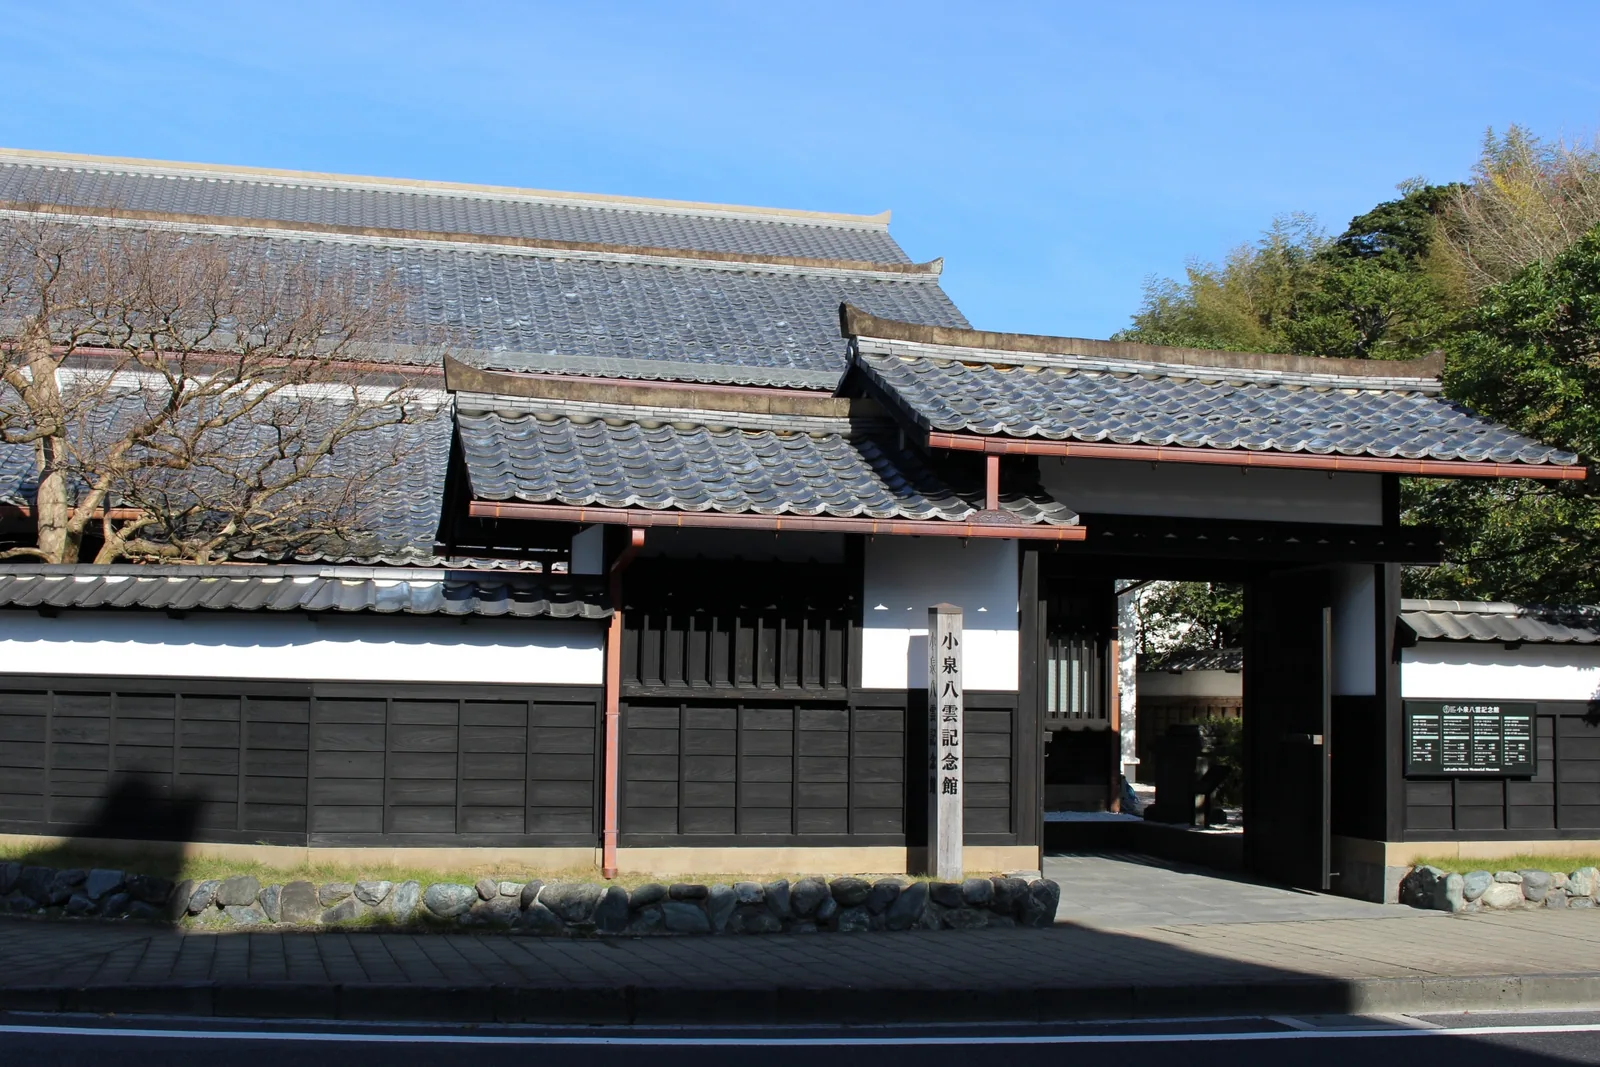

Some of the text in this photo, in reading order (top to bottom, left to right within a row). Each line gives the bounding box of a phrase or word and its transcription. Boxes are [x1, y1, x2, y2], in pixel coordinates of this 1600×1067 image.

[941, 632, 959, 795] 小泉八雲記念館
